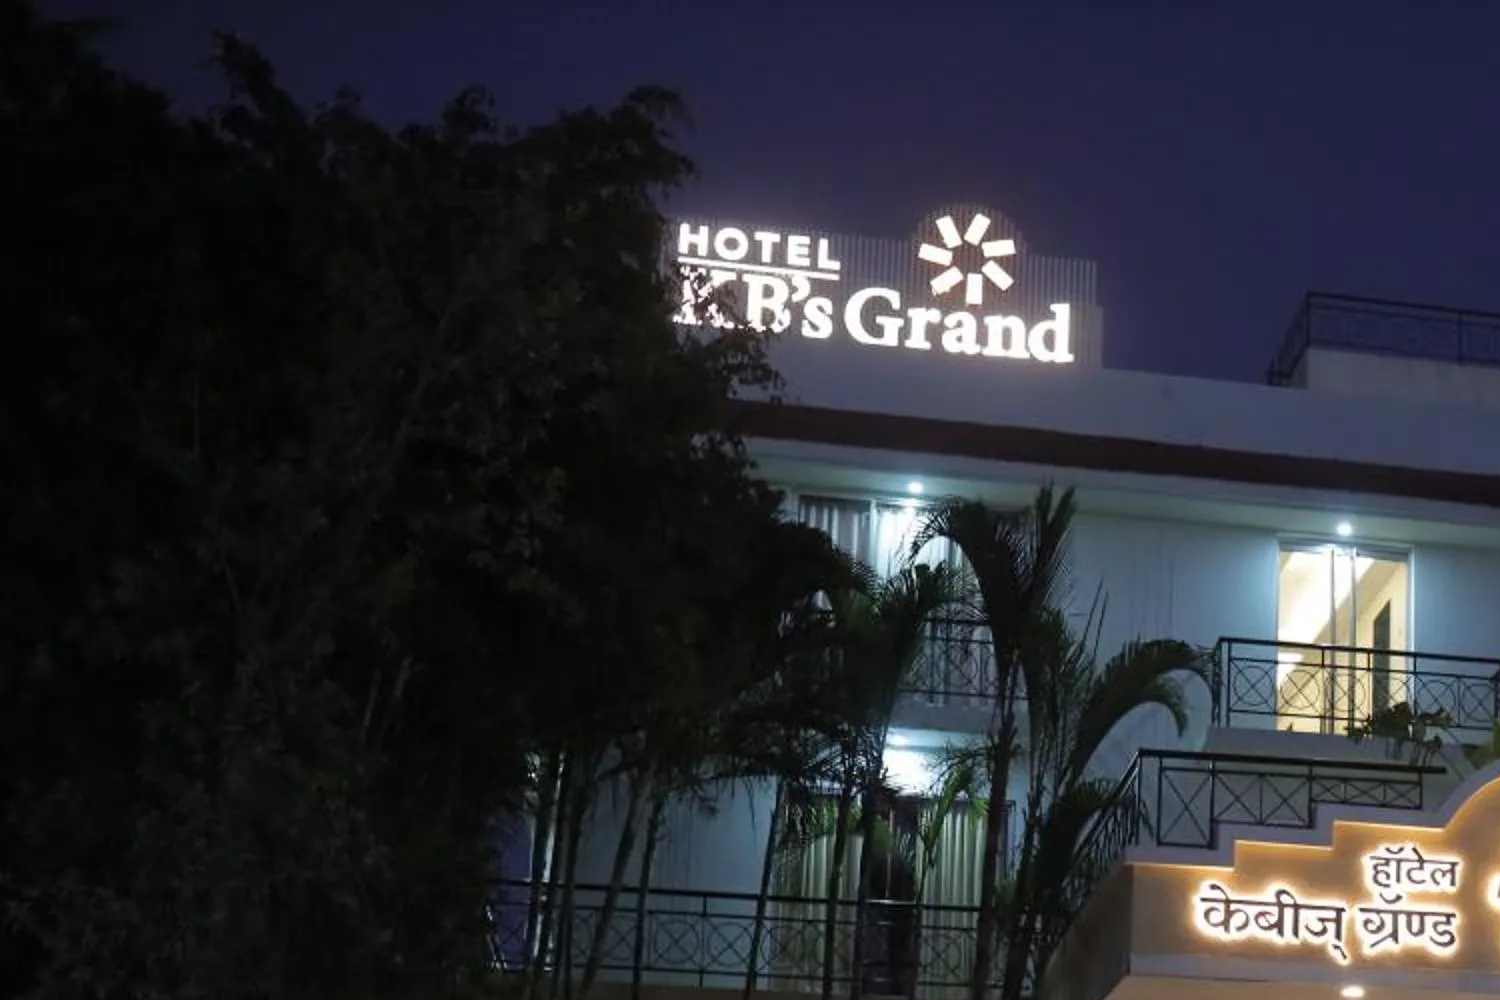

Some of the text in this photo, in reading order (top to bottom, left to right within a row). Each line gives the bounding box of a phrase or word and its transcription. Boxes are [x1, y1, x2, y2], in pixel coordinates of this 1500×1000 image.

[677, 222, 842, 271] HOTEL
[673, 266, 1075, 364] KB's Grand
[1369, 846, 1459, 888] हॉटेल
[1199, 883, 1348, 960] केबीज्
